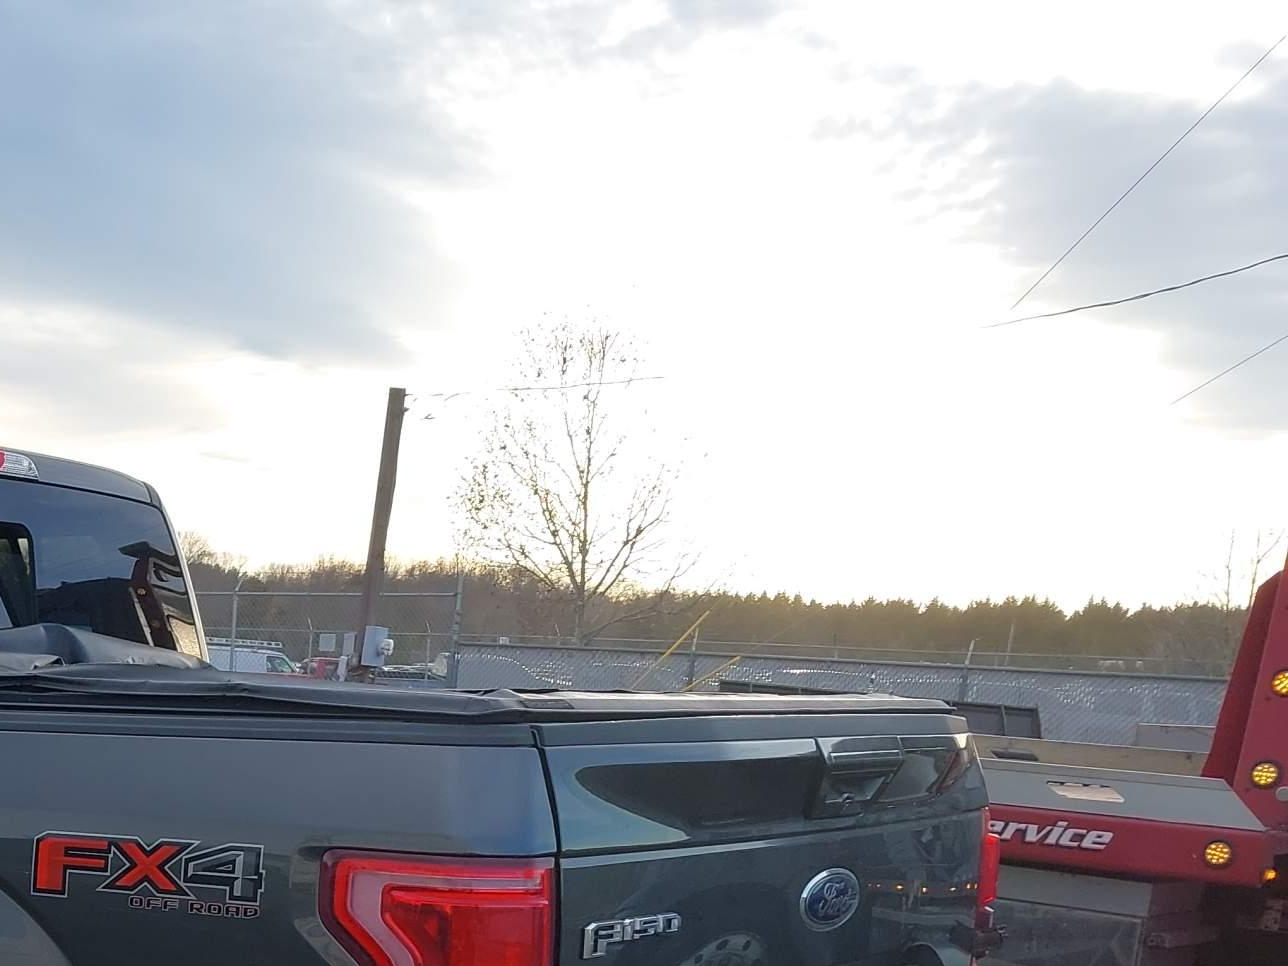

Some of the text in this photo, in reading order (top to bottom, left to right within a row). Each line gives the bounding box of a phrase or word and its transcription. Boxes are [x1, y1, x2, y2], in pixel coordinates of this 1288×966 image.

[31, 831, 265, 904] FX4
[128, 895, 260, 918] OFF ROAD
